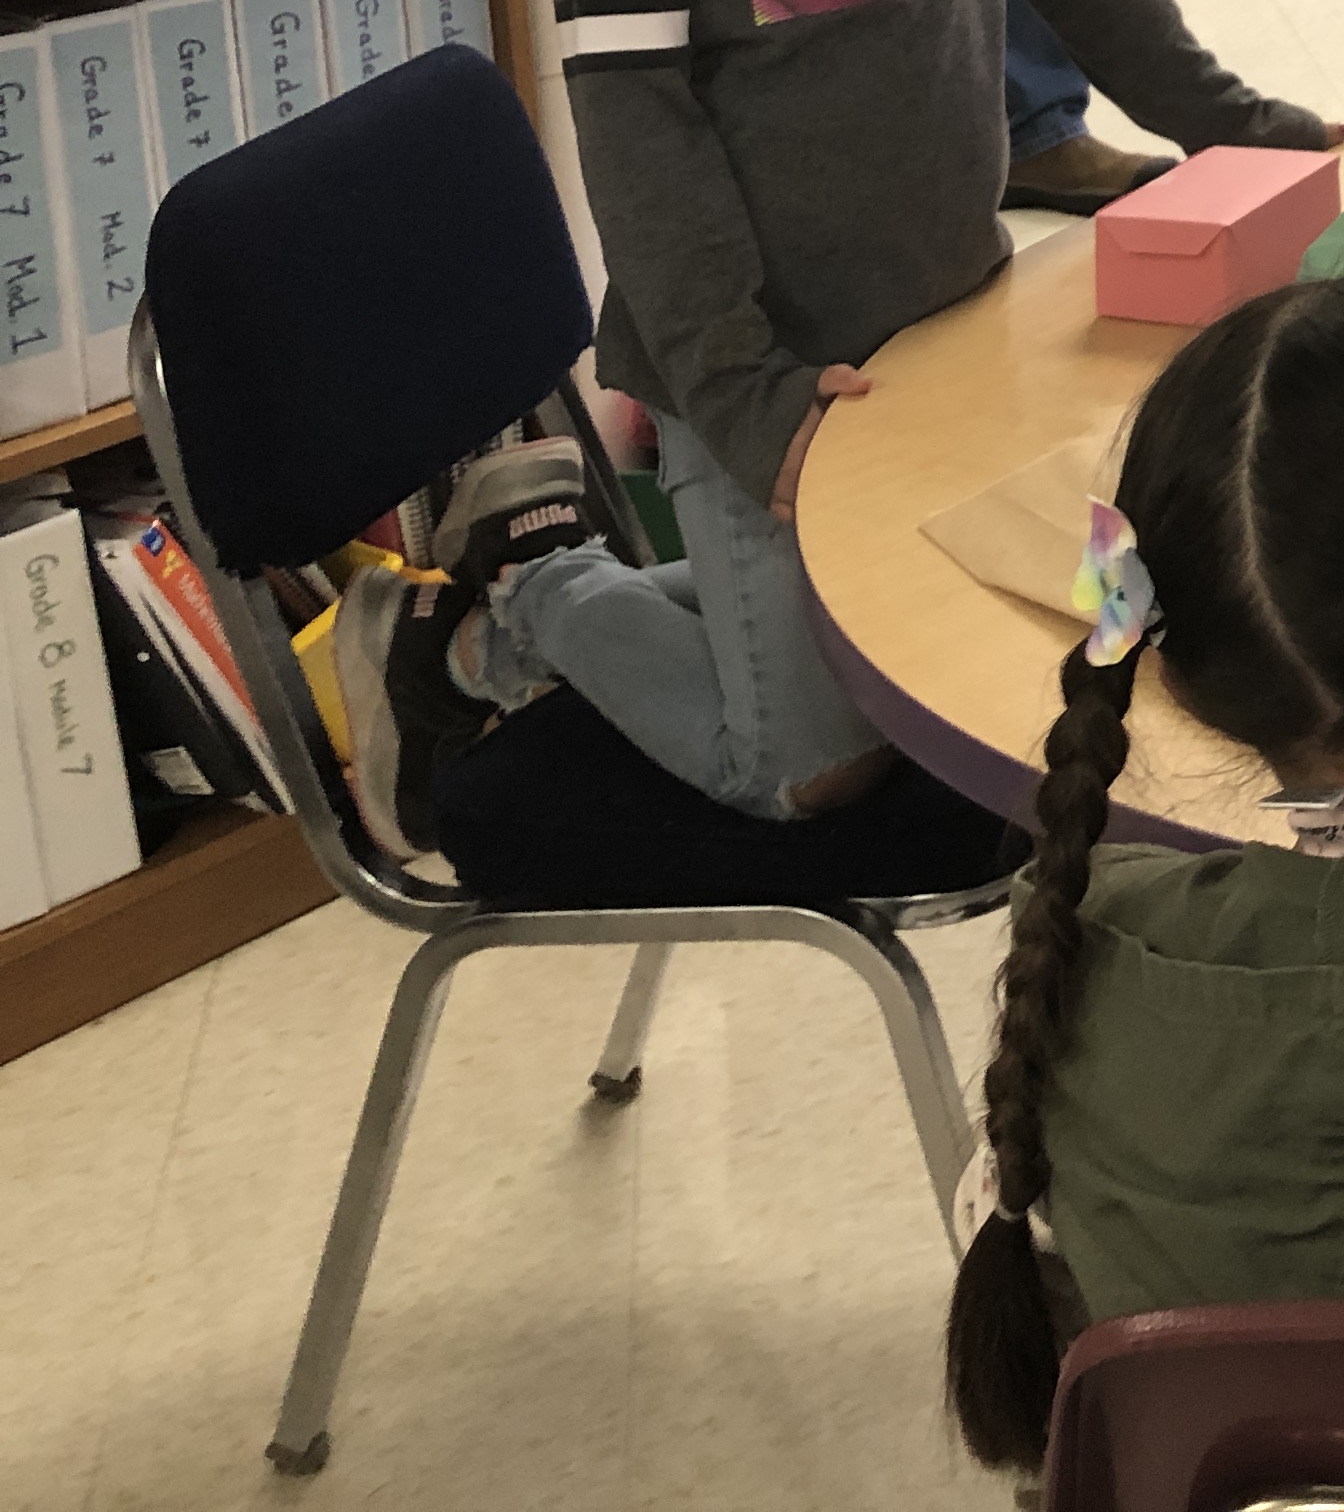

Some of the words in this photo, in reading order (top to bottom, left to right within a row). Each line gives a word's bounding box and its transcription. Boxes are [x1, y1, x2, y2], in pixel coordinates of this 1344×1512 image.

[270, 11, 303, 118] Grade
[177, 38, 210, 123] Grade
[80, 55, 111, 140] Grade
[189, 129, 212, 148] 7
[92, 151, 116, 166] 7
[107, 277, 134, 301] 2
[12, 328, 48, 355] 1
[25, 554, 62, 633] Grade
[38, 639, 76, 668] 8
[60, 752, 94, 775] 7
